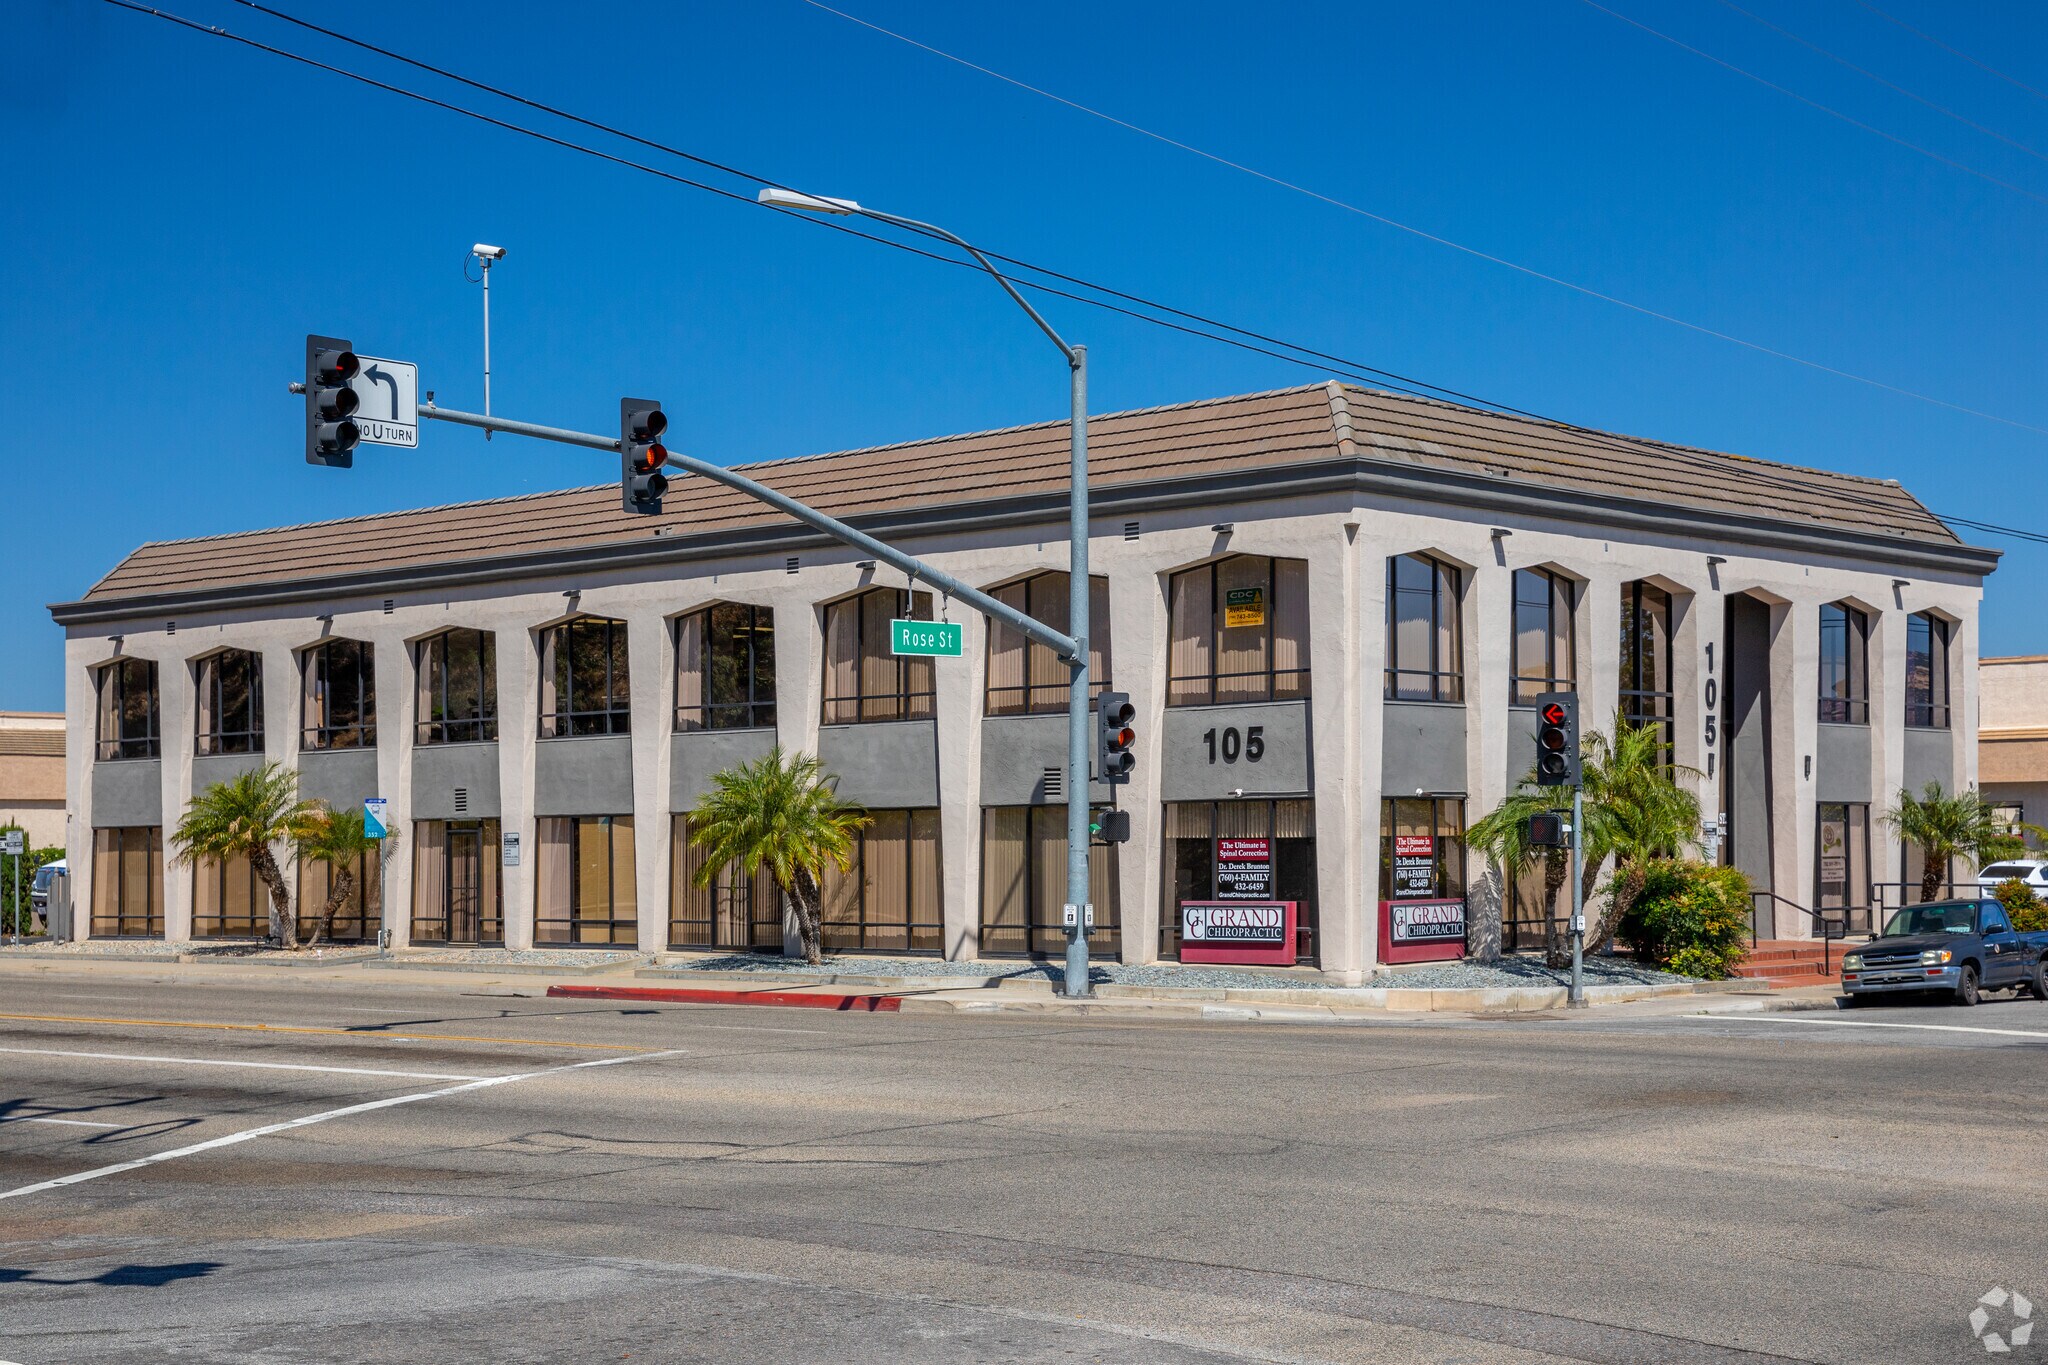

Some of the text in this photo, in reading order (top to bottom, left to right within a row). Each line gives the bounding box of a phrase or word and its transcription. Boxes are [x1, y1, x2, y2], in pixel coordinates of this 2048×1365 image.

[373, 424, 383, 439] U
[385, 427, 412, 441] TURN
[1230, 591, 1253, 599] CDC
[1229, 604, 1261, 613] AVAILABLE
[903, 629, 952, 648] Rose St
[1203, 726, 1264, 765] 105
[1220, 850, 1238, 858] Spinal
[1218, 873, 1270, 883] (760) 4-FAMILY
[1234, 883, 1264, 891] 432-6459
[1211, 908, 1279, 927] GRAND
[1412, 906, 1459, 924] GRAND
[1207, 927, 1281, 938] CHIROPRACTIC
[1408, 923, 1462, 936] CHIROPRACTIC
